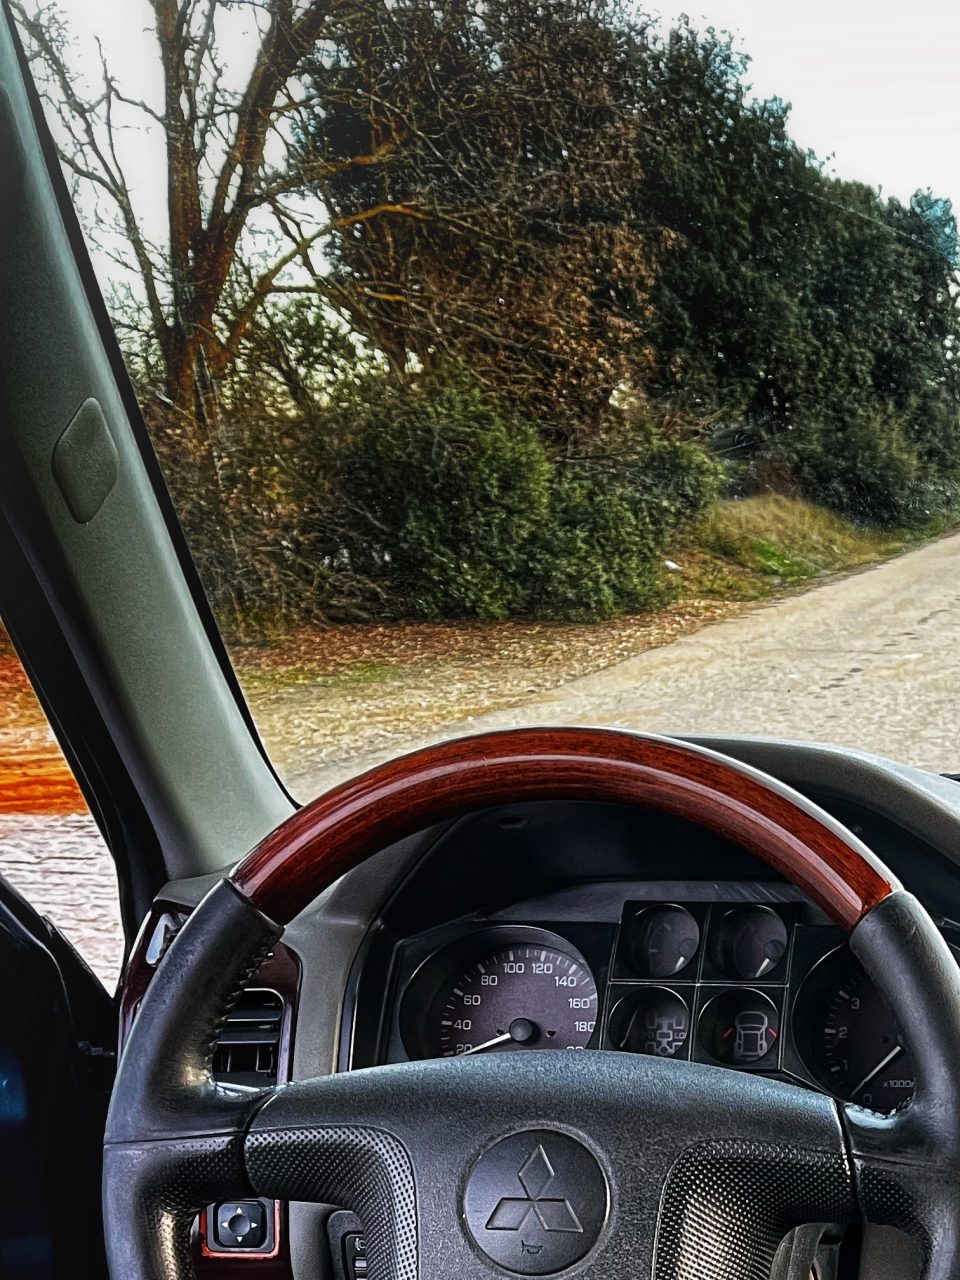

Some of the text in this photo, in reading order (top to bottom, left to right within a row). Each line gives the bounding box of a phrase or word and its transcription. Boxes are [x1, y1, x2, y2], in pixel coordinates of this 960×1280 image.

[503, 962, 525, 974] 100
[531, 962, 553, 974] 120
[480, 975, 498, 986] 80
[554, 976, 577, 987] 140
[463, 994, 481, 1006] 60
[568, 998, 590, 1009] 160
[850, 997, 860, 1010] 3
[453, 1019, 472, 1031] 40
[574, 1021, 596, 1032] 180
[838, 1026, 848, 1039] 2
